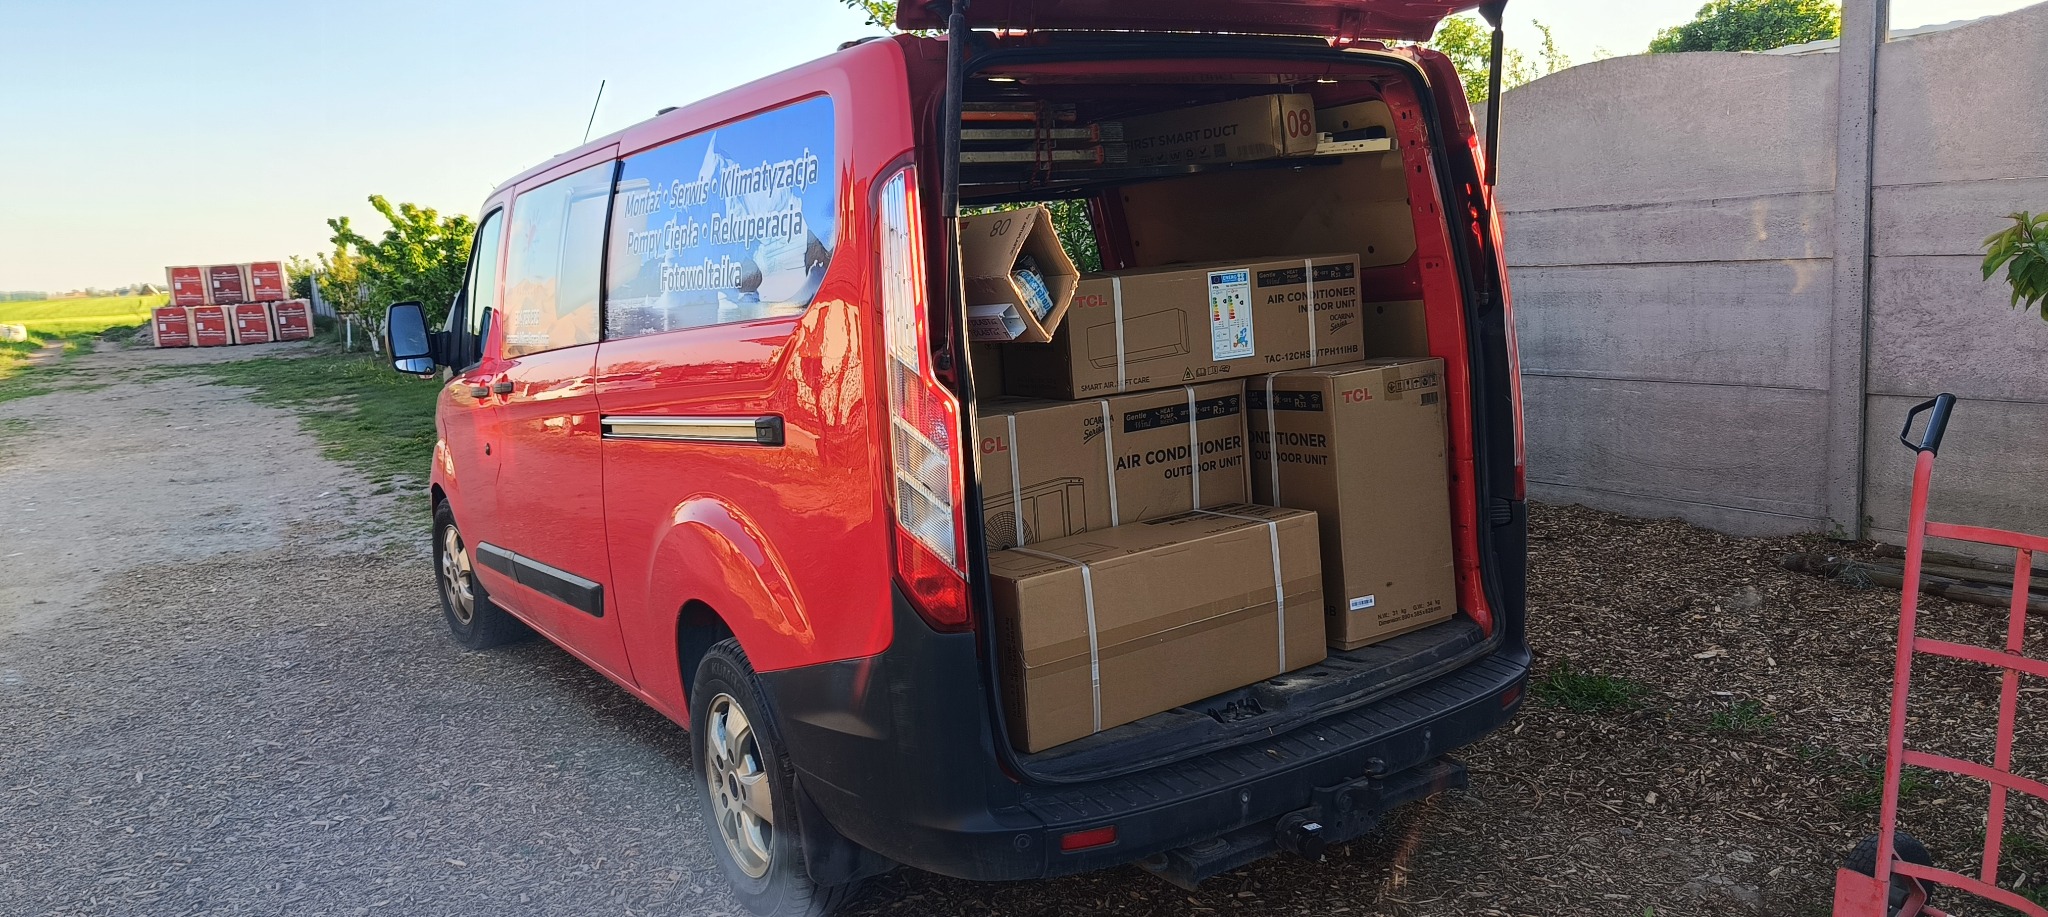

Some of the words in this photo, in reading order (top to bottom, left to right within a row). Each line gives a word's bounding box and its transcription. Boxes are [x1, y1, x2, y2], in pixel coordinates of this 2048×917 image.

[1287, 108, 1312, 139] 08
[1158, 129, 1201, 147] SMART
[1203, 123, 1239, 138] DUCT
[625, 183, 662, 218] Montaż
[670, 175, 710, 209] Serwis
[719, 148, 819, 199] Klimatyzacja
[626, 226, 662, 259] Pompy
[664, 215, 699, 256] Ciepła
[710, 203, 803, 250] Rekuperacja
[660, 254, 743, 292] Fotowoltaika
[1075, 294, 1108, 308] TCL
[1267, 294, 1284, 304] AIR
[1298, 301, 1334, 313] INOOR
[1335, 299, 1356, 309] UNIT
[1329, 312, 1355, 321] OCARINA
[1265, 344, 1359, 363] TAC-12CHS/TPH11IHB
[1081, 383, 1103, 392] SMART
[1133, 376, 1150, 385] CARE
[1294, 398, 1307, 408] R32
[1341, 387, 1373, 404] TCL
[1126, 413, 1147, 421] Gentle
[1213, 404, 1225, 415] R32
[1083, 414, 1115, 427] OCARA
[980, 436, 1008, 454] CL
[1250, 430, 1327, 448] NDTIONER
[1116, 453, 1141, 471] AIR
[1145, 435, 1241, 465] CONDIIONER
[1304, 454, 1328, 466] UNIT
[1218, 455, 1242, 469] UNIT
[711, 662, 744, 697] KUMHO
